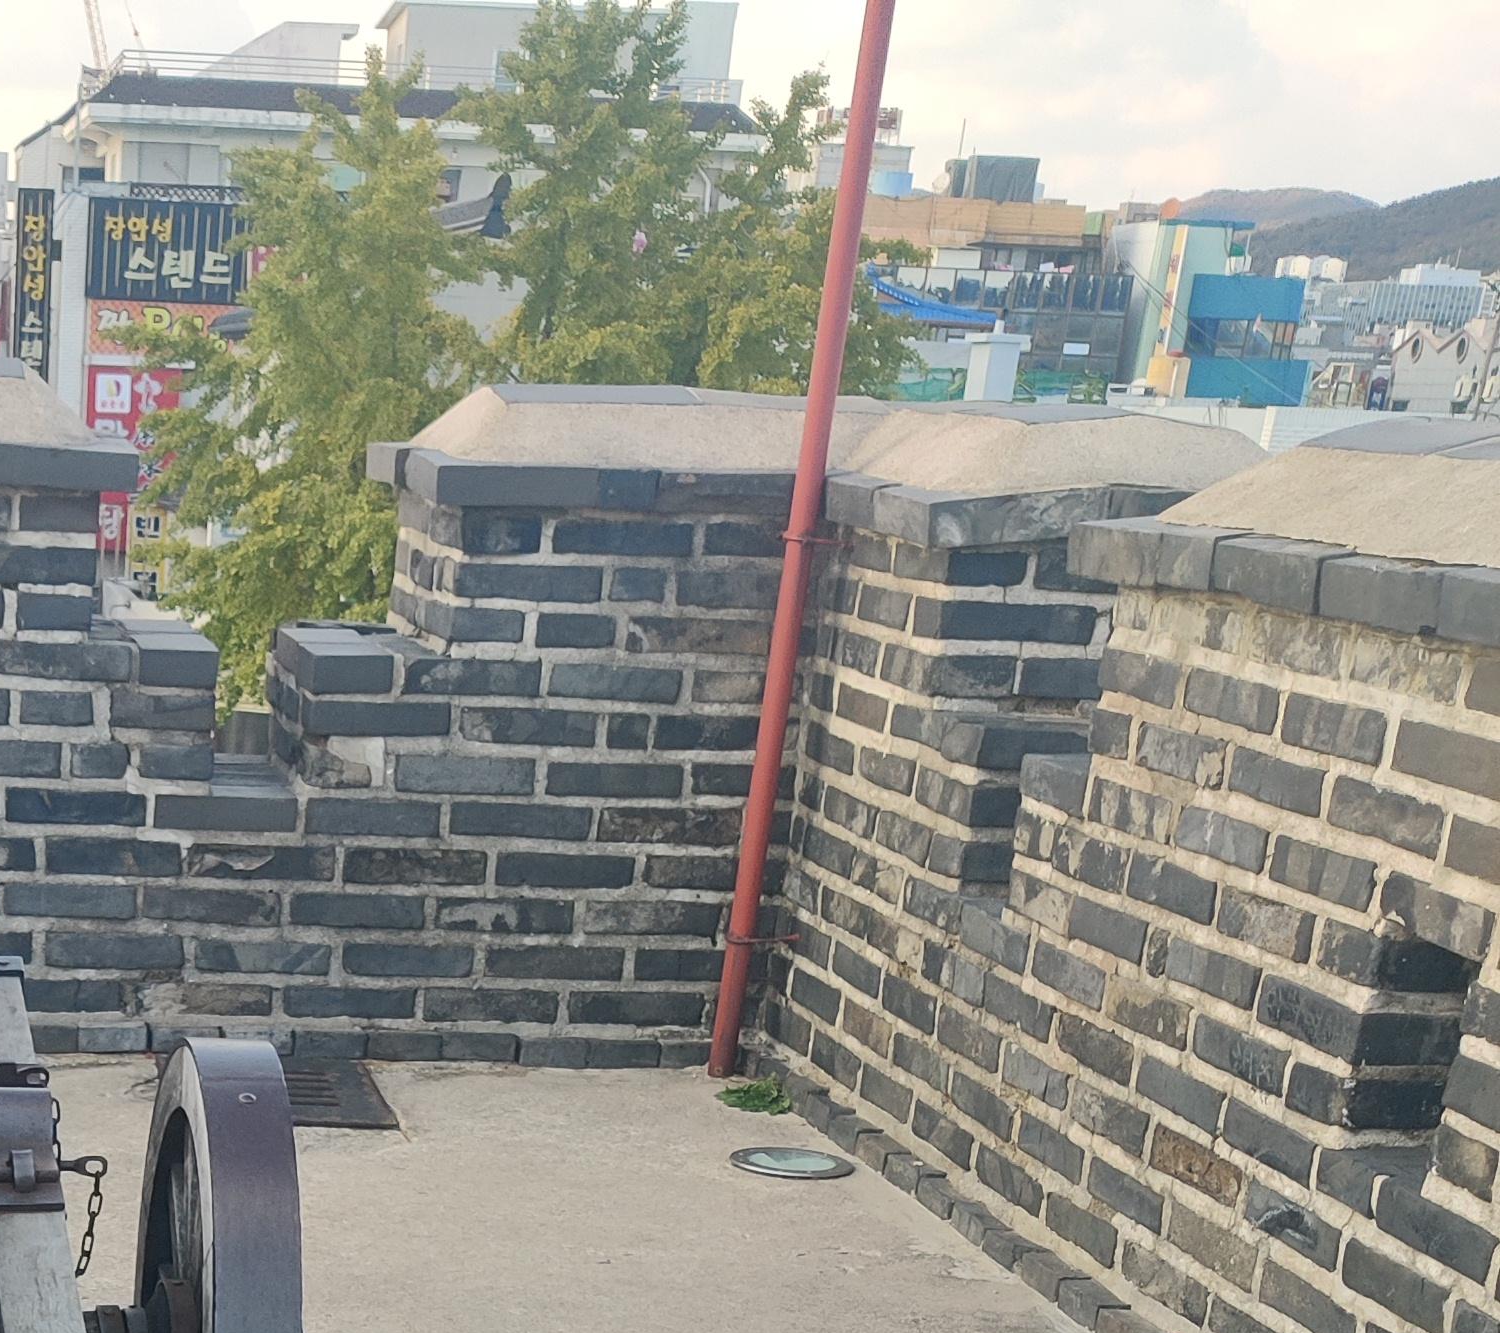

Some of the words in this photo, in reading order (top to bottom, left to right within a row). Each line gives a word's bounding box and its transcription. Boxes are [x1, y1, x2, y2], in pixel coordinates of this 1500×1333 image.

[105, 215, 173, 243] 장안성
[22, 214, 47, 301] 장안성
[124, 247, 232, 289] 스텐드
